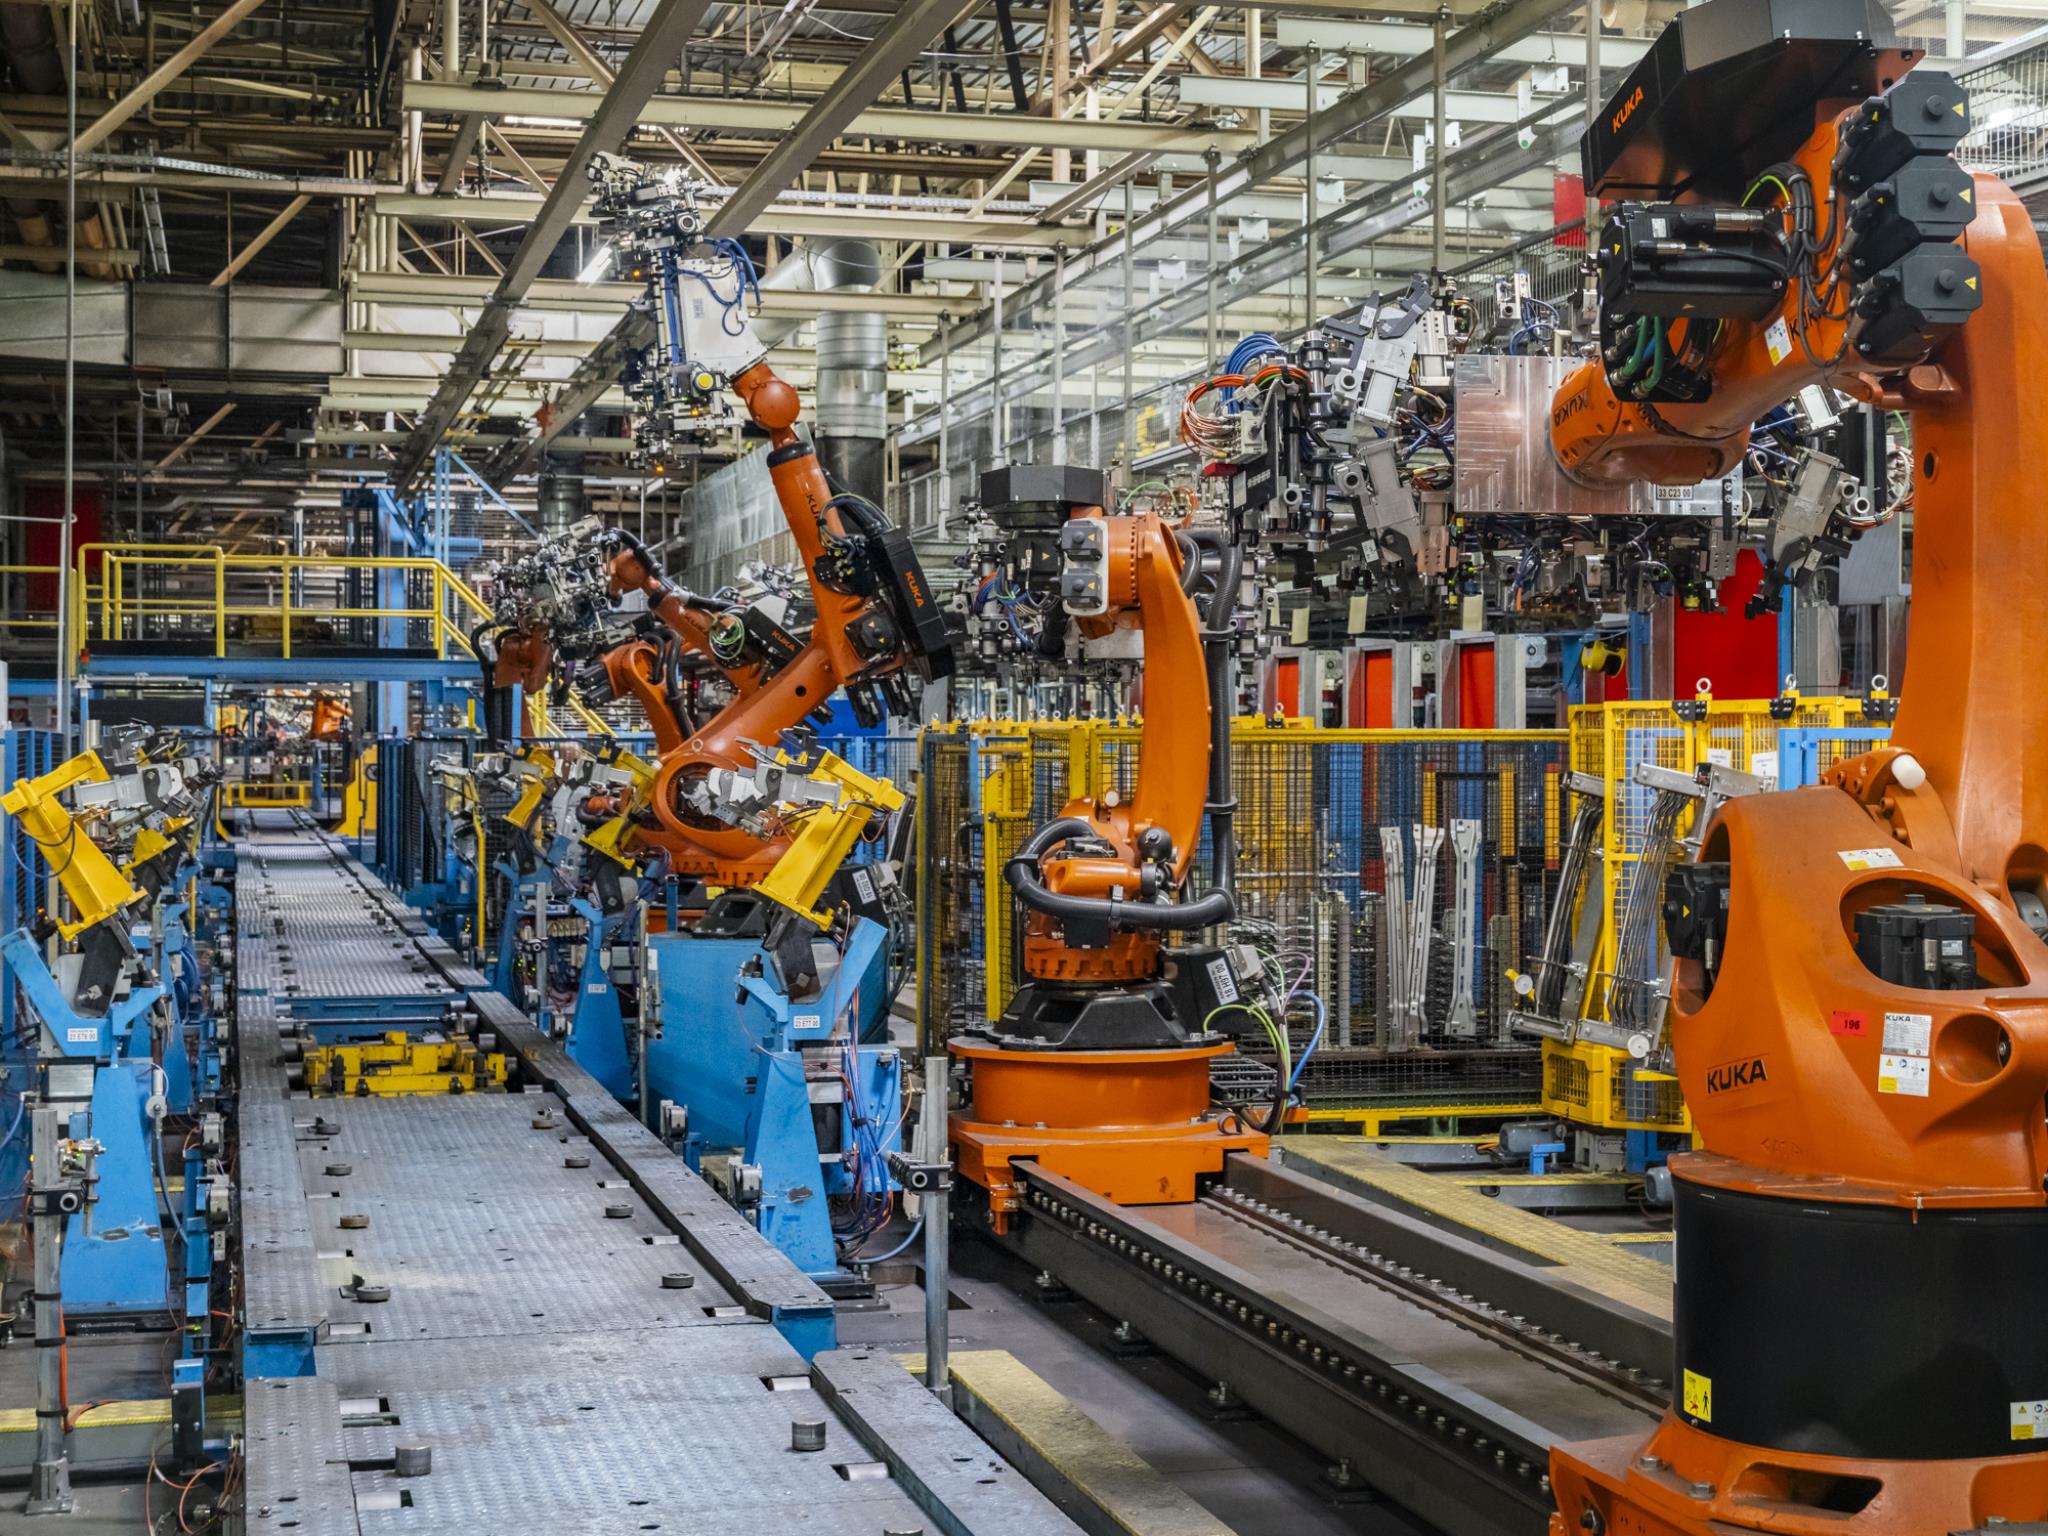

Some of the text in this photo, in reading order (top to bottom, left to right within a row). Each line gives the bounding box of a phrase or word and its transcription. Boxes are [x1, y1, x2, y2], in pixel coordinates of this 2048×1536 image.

[1612, 86, 1644, 135] KUKA
[1554, 389, 1588, 427] KUKA
[1658, 488, 1667, 498] 33
[904, 570, 925, 608] KUKA
[771, 631, 796, 651] KUKA
[1215, 963, 1226, 974] 00
[1218, 974, 1232, 989] H97
[1224, 988, 1236, 999] 18
[1844, 1019, 1860, 1030] 196
[1706, 1058, 1768, 1095] KUKA
